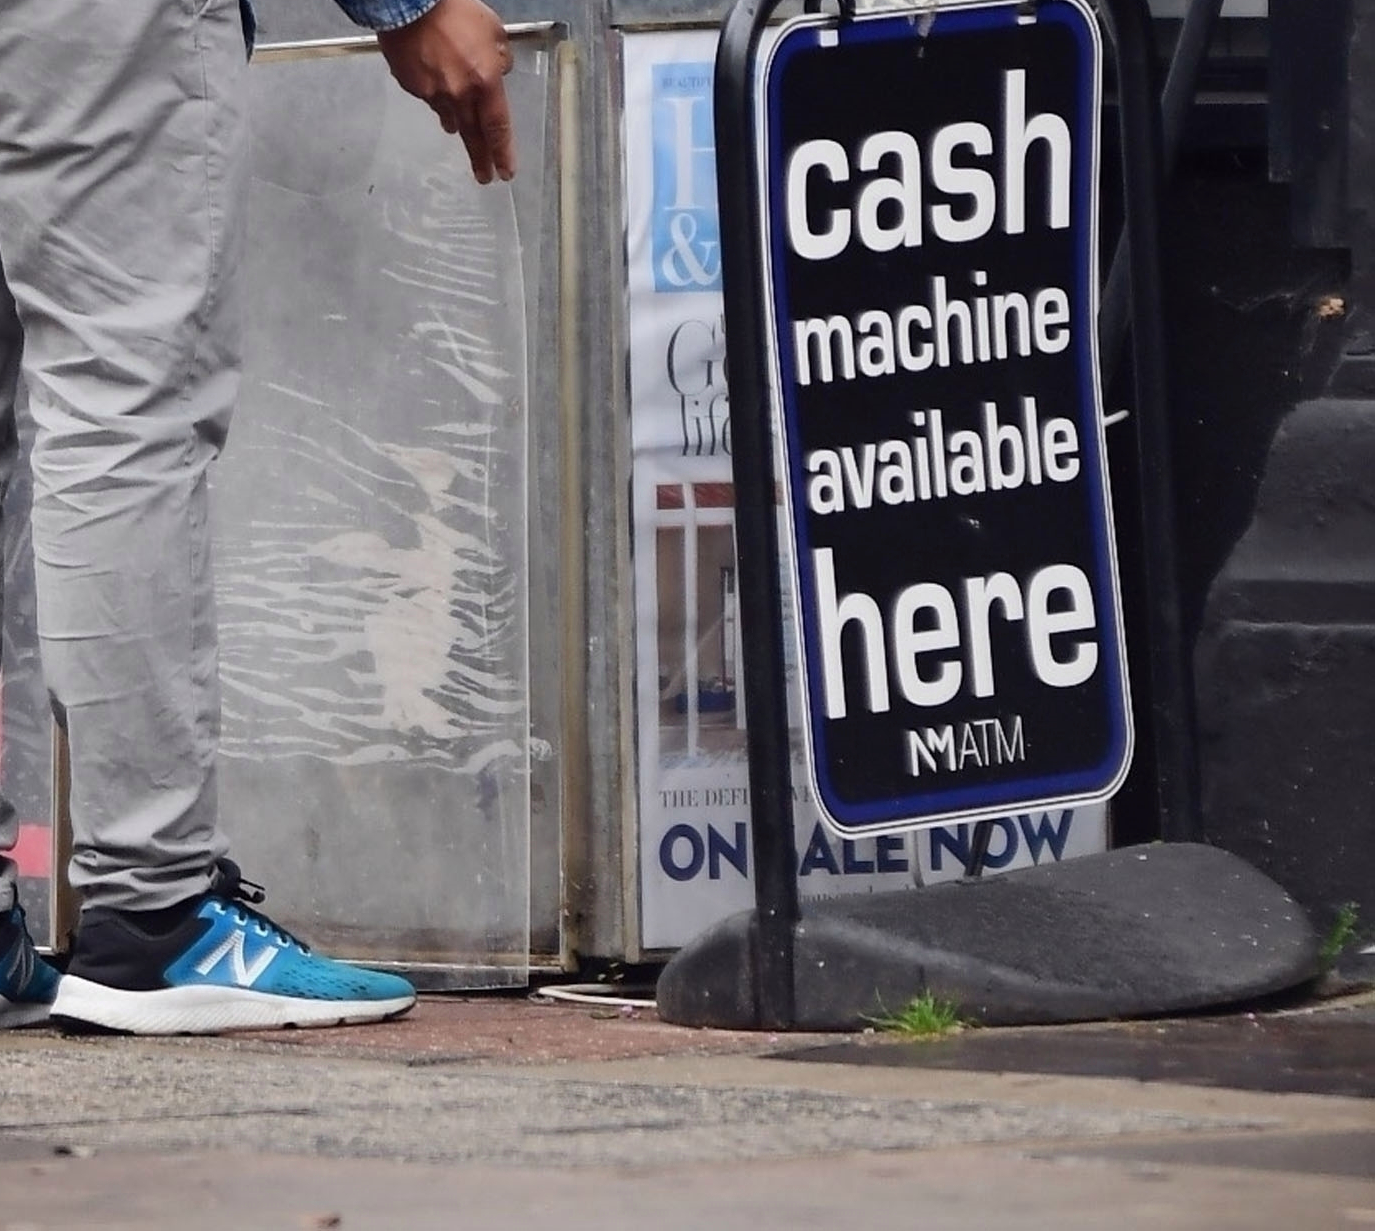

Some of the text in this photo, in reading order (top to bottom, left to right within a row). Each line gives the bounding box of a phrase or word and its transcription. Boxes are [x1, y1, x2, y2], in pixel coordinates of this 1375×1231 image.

[785, 68, 1072, 261] cash
[793, 271, 1071, 386] machine
[805, 396, 1081, 515] available
[812, 548, 1099, 720] here
[658, 809, 1075, 881] ON ALE NOW
[659, 789, 700, 809] THE
